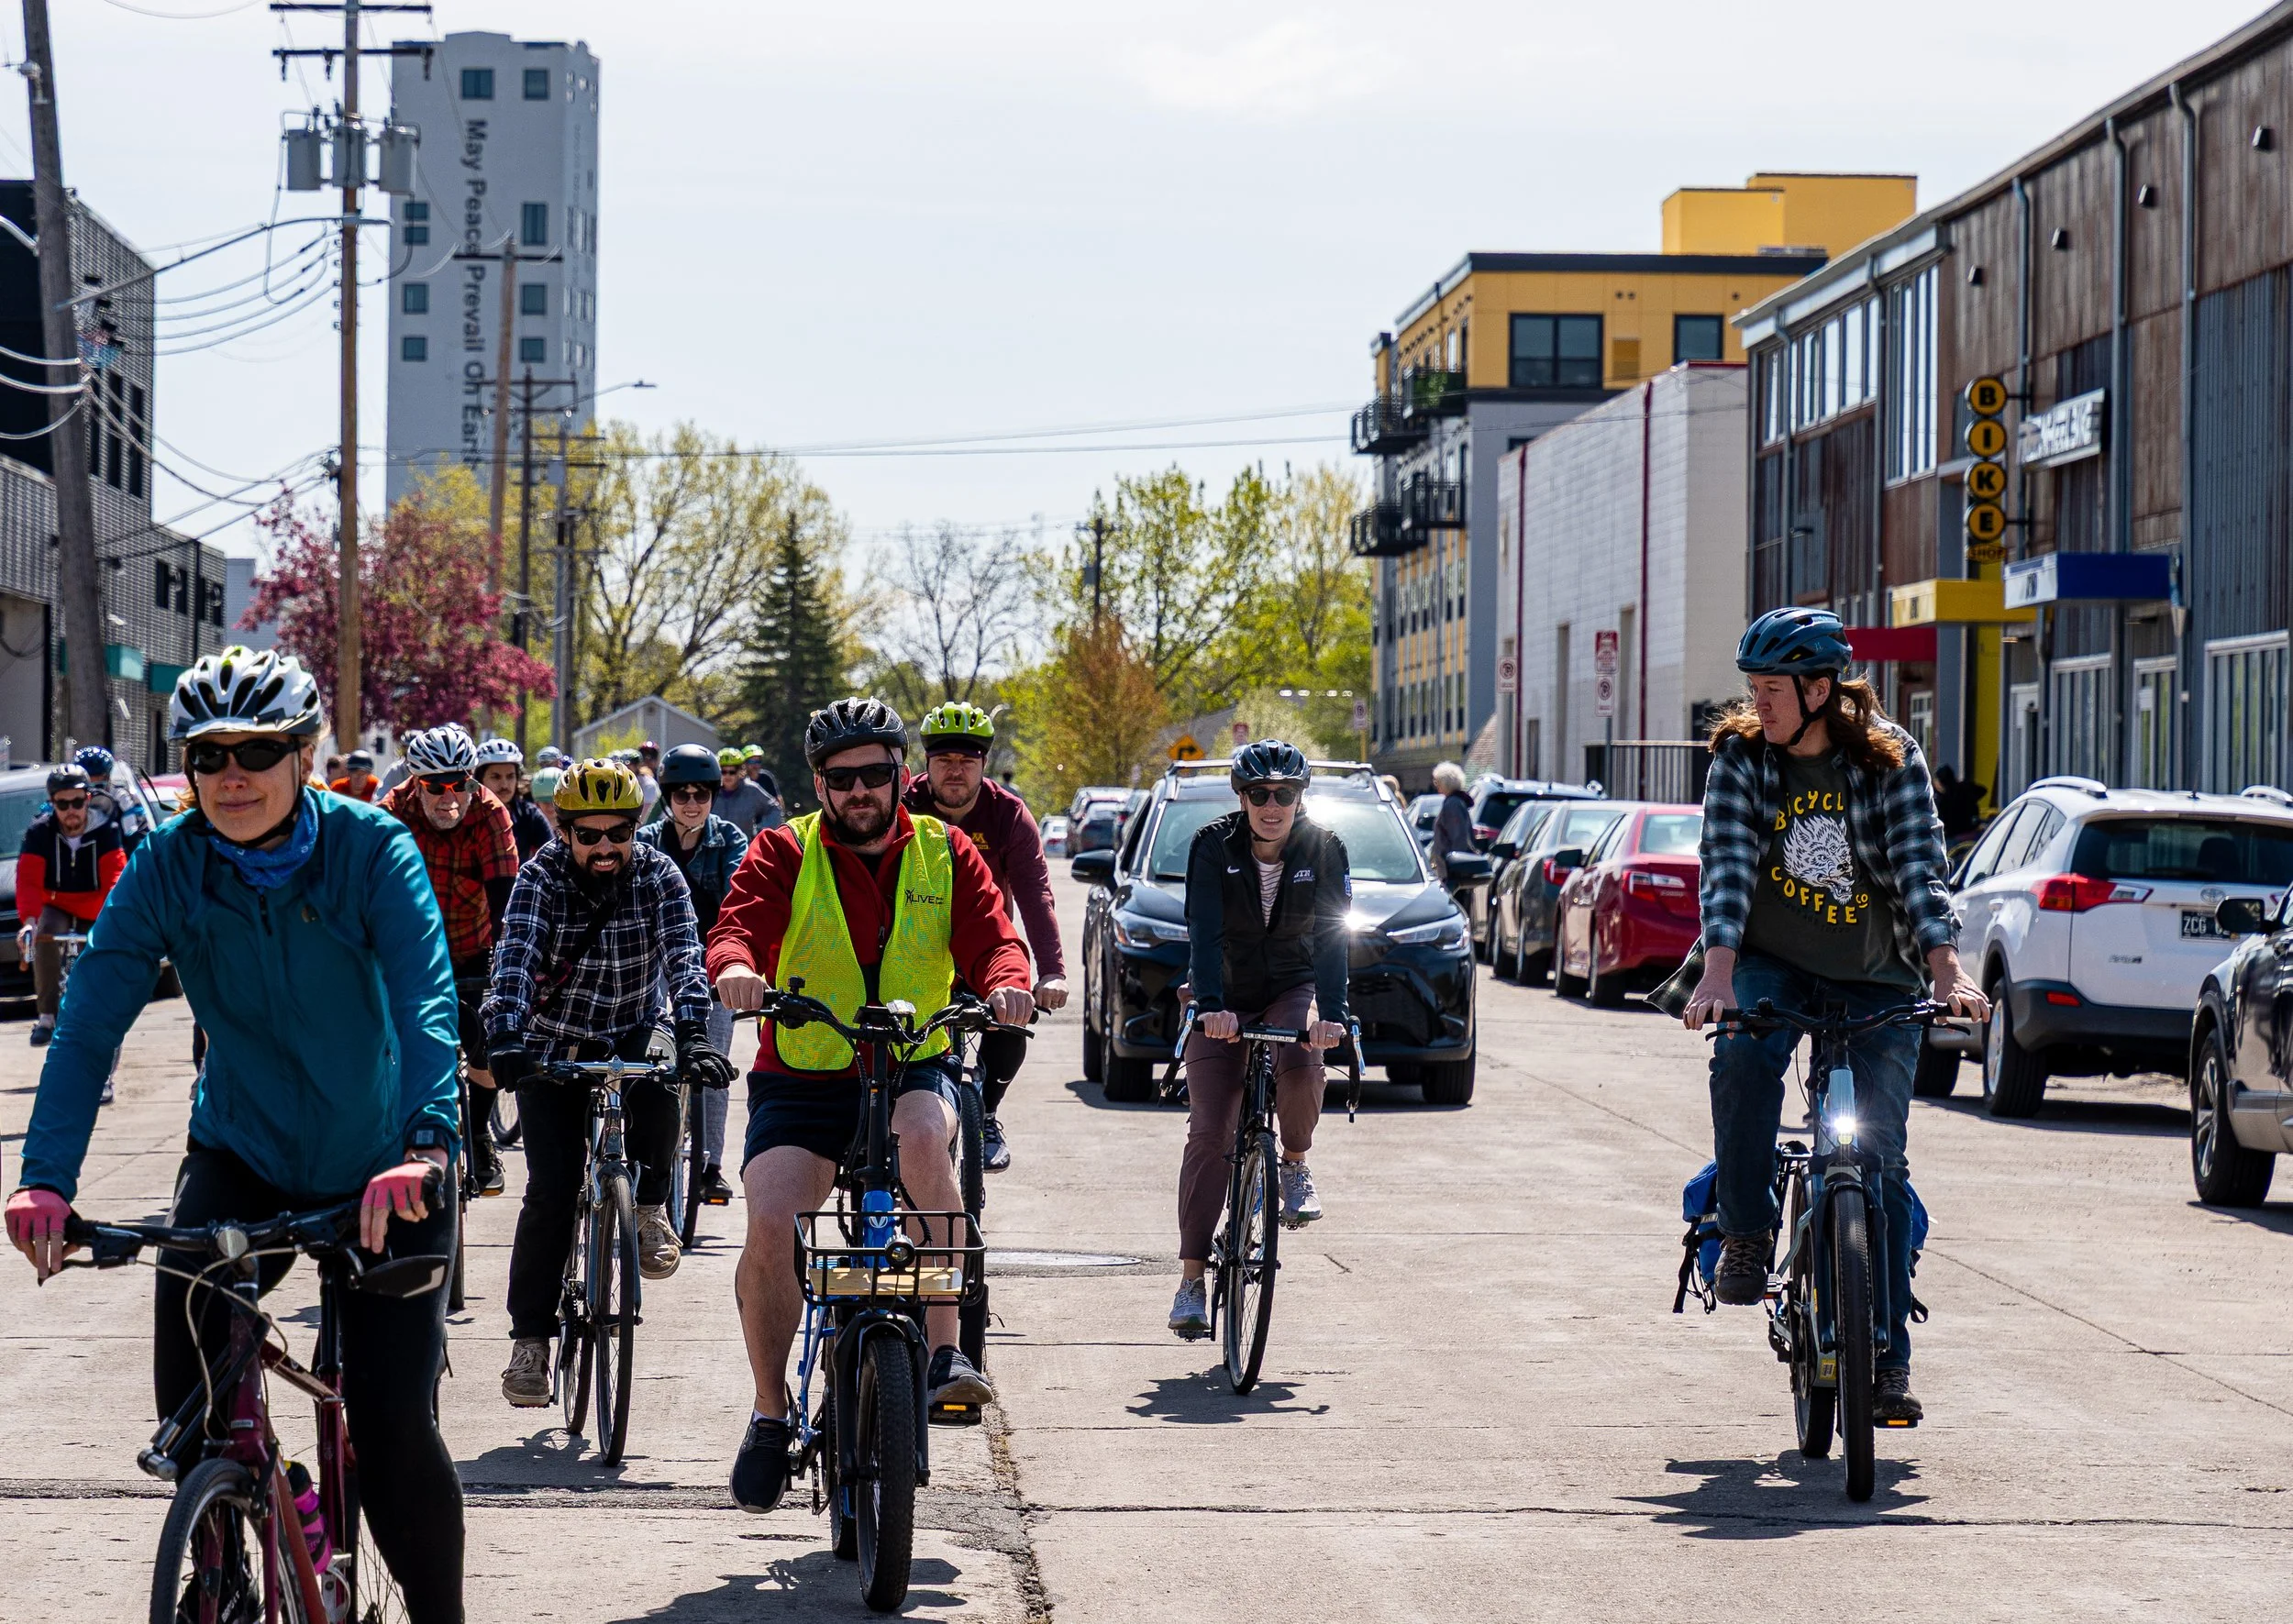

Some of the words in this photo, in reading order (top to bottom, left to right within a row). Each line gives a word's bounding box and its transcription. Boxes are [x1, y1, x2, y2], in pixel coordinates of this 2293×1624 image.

[460, 119, 488, 171] May
[465, 179, 487, 257] Peace
[463, 263, 486, 352] Prevail
[464, 360, 485, 395] On
[1977, 387, 1997, 532] BIKE
[1774, 790, 1844, 831] BICYCL
[1771, 867, 1857, 923] COFFEE
[2184, 916, 2207, 934] ZCG
